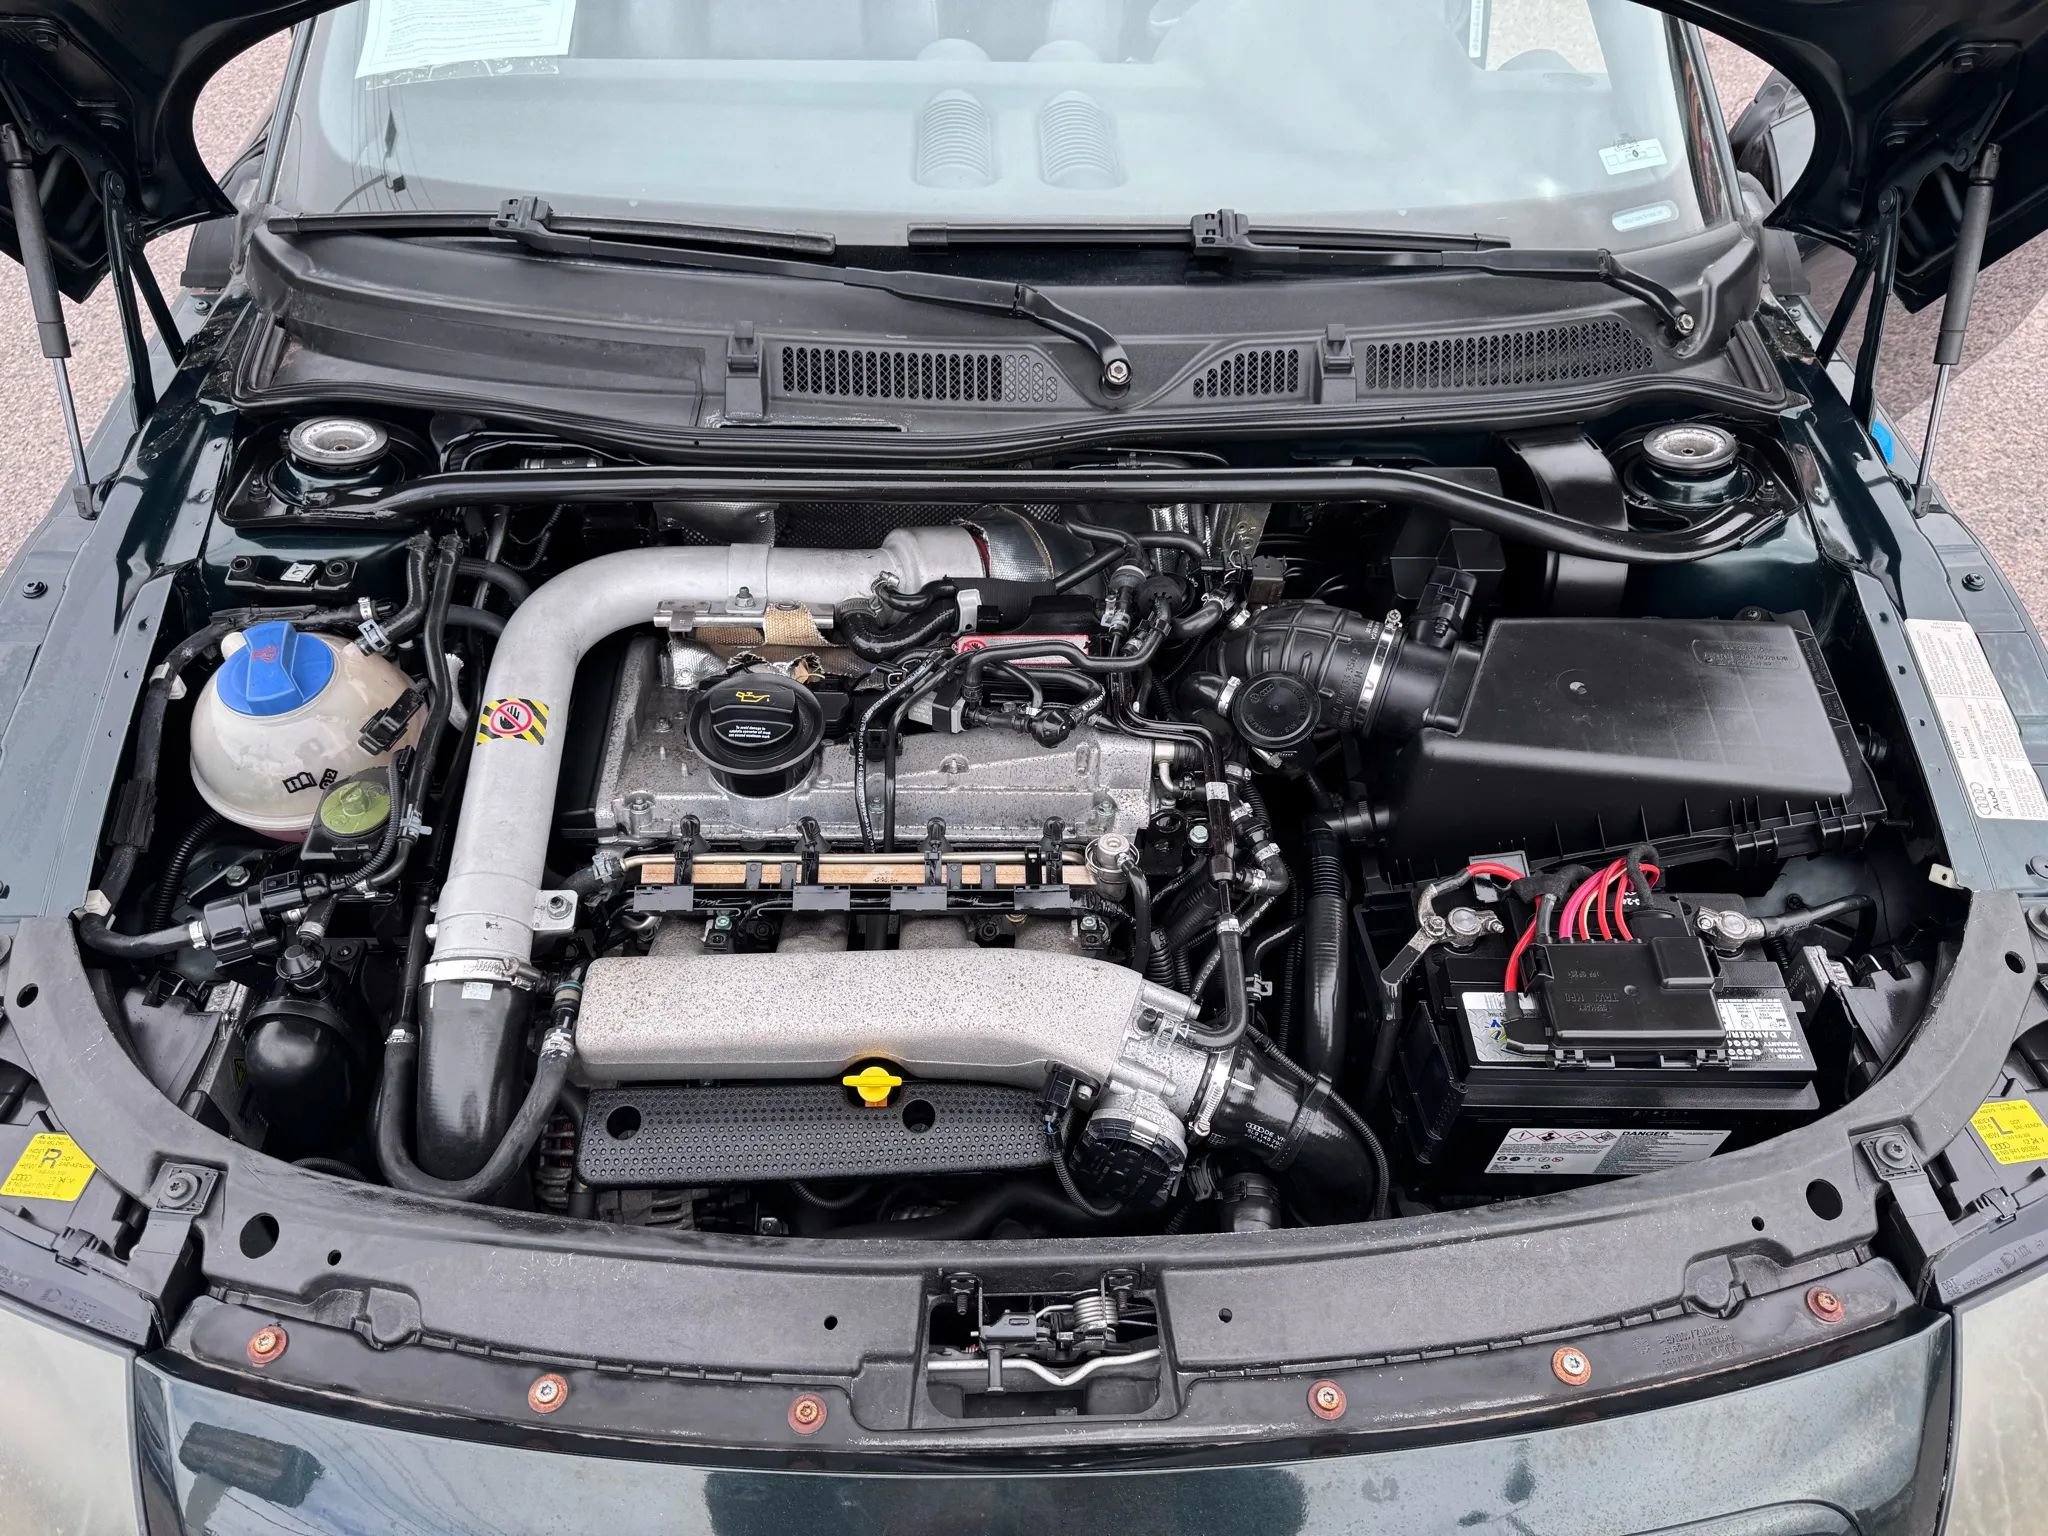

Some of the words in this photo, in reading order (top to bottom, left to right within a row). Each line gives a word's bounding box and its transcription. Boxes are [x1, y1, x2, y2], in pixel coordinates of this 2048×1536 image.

[1988, 786, 2001, 812] Audi
[1990, 1116, 2014, 1135] L
[38, 1148, 62, 1169] R
[1941, 1278, 1957, 1291] DOT
